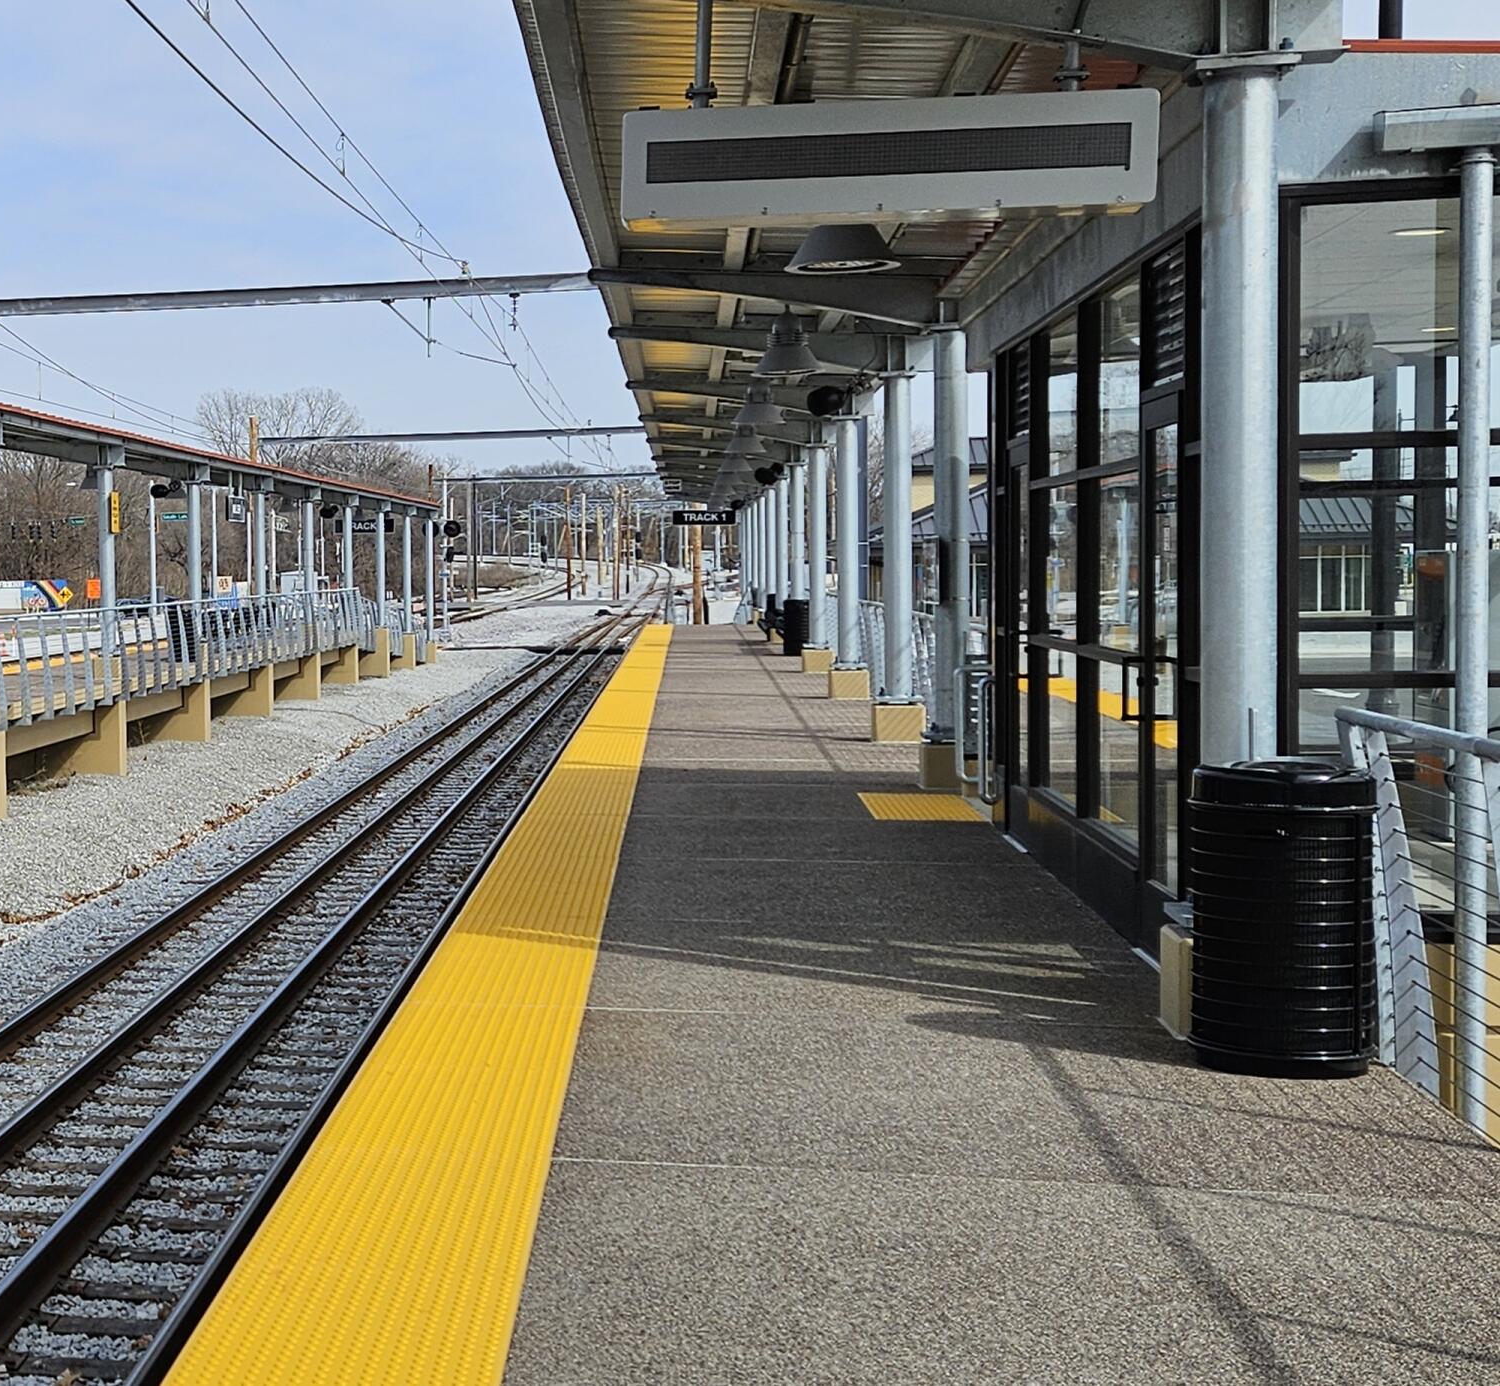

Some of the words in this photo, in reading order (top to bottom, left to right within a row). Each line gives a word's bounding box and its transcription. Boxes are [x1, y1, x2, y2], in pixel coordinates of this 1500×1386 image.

[683, 513, 719, 521] TRACK
[721, 513, 726, 521] 1
[351, 521, 377, 531] RACK
